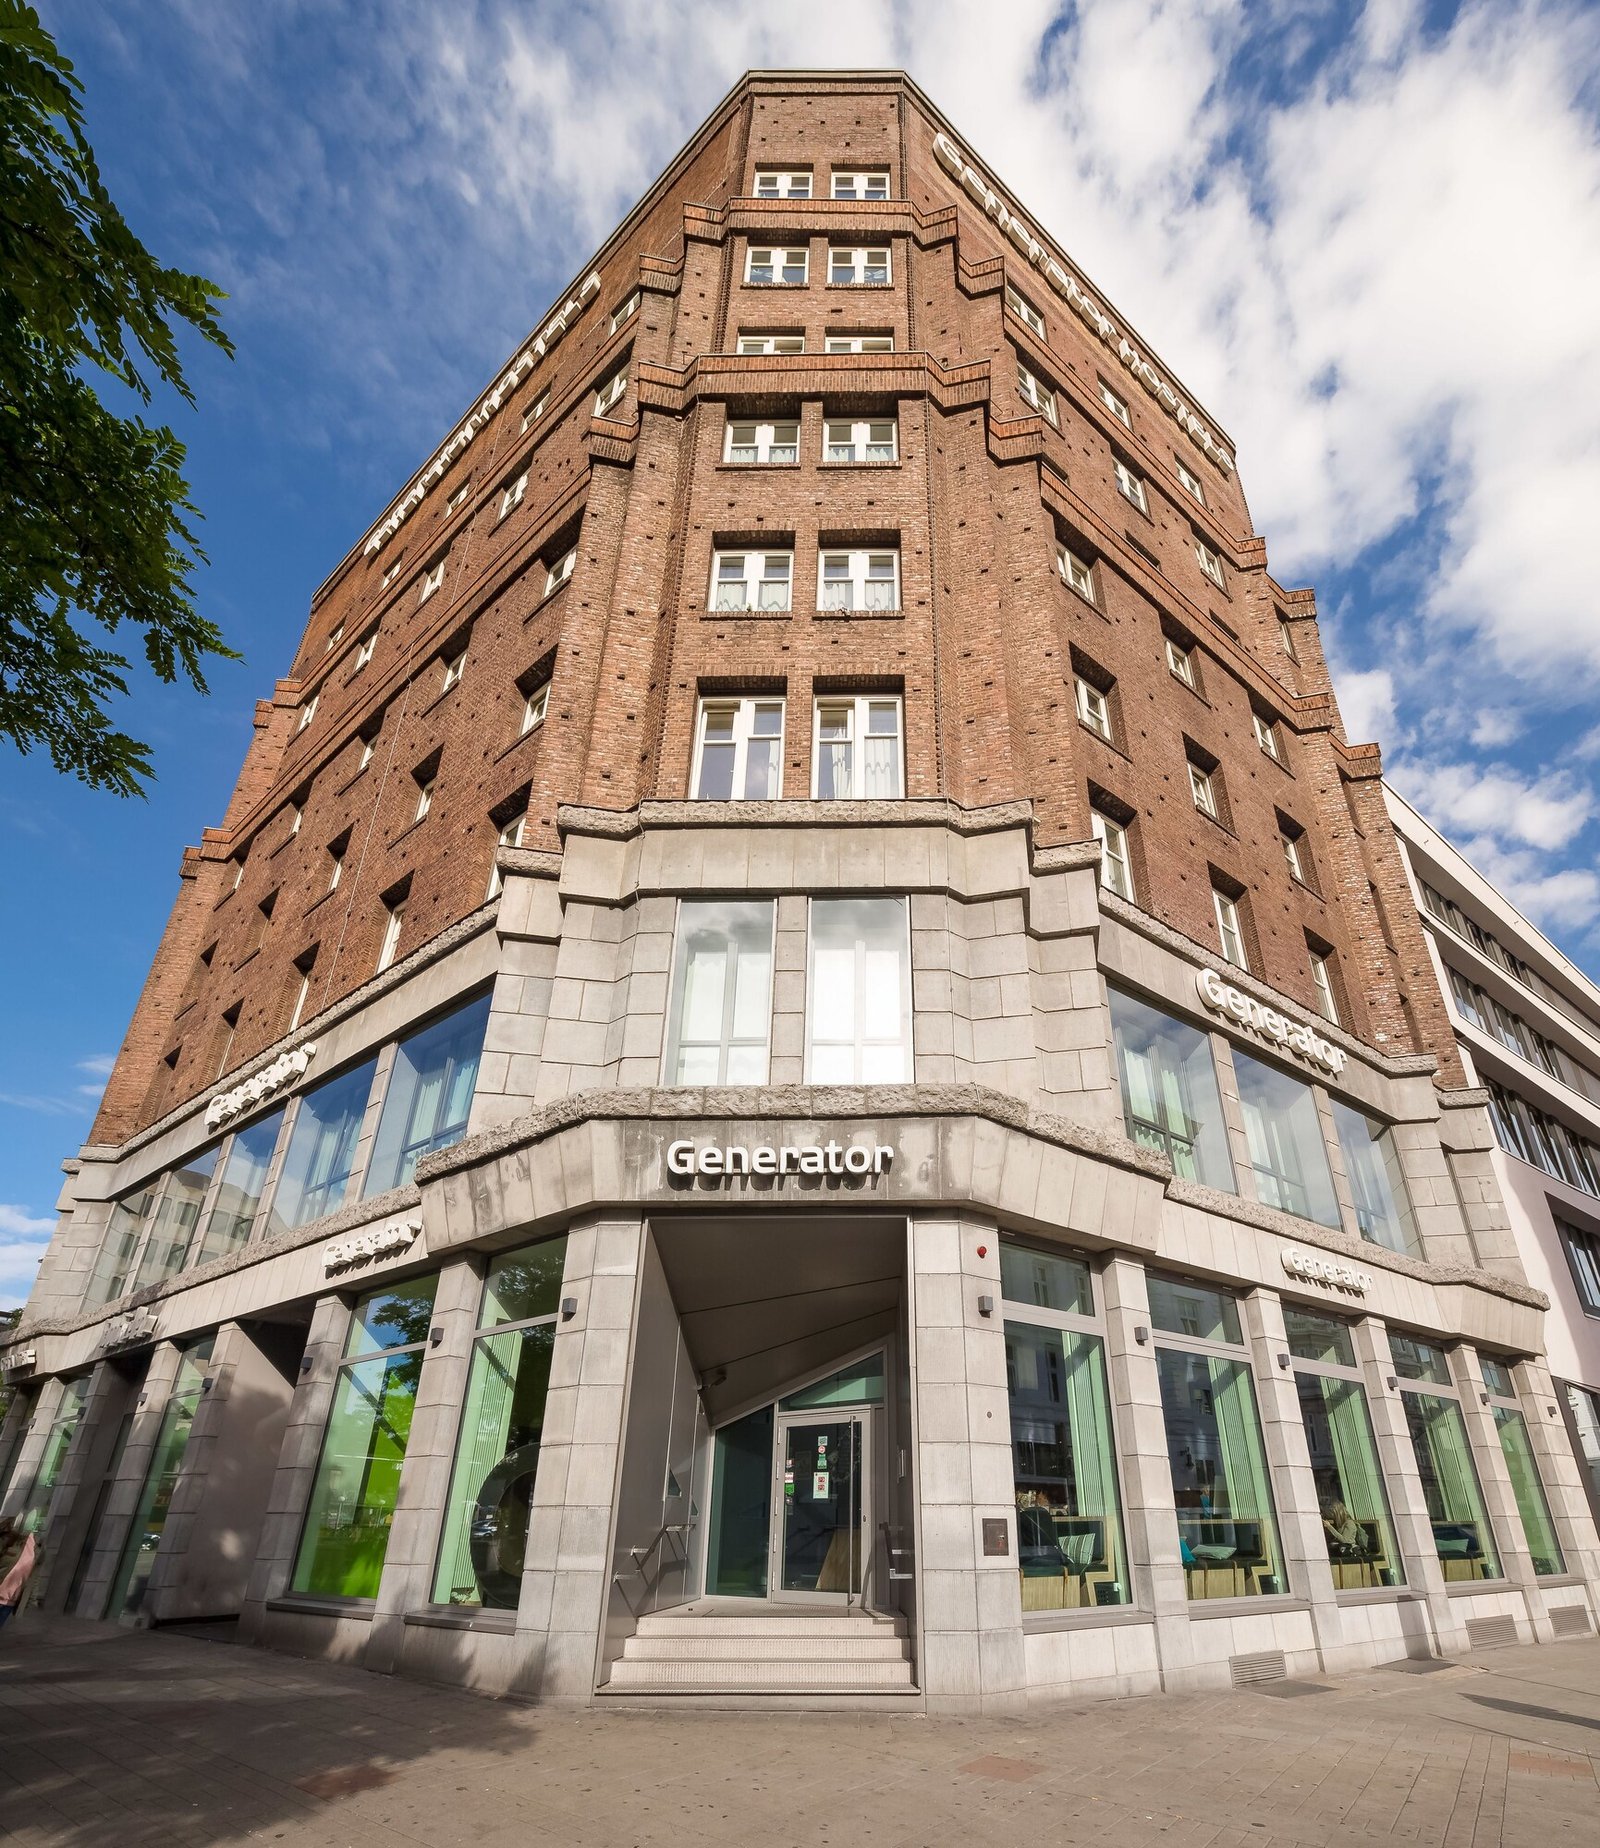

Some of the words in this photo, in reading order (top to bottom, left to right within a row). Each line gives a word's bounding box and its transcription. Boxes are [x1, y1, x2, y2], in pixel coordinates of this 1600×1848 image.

[932, 132, 1117, 340] Generator
[1196, 967, 1347, 1073] Generator
[667, 1139, 894, 1175] Generator
[1281, 1247, 1373, 1292] Generator
